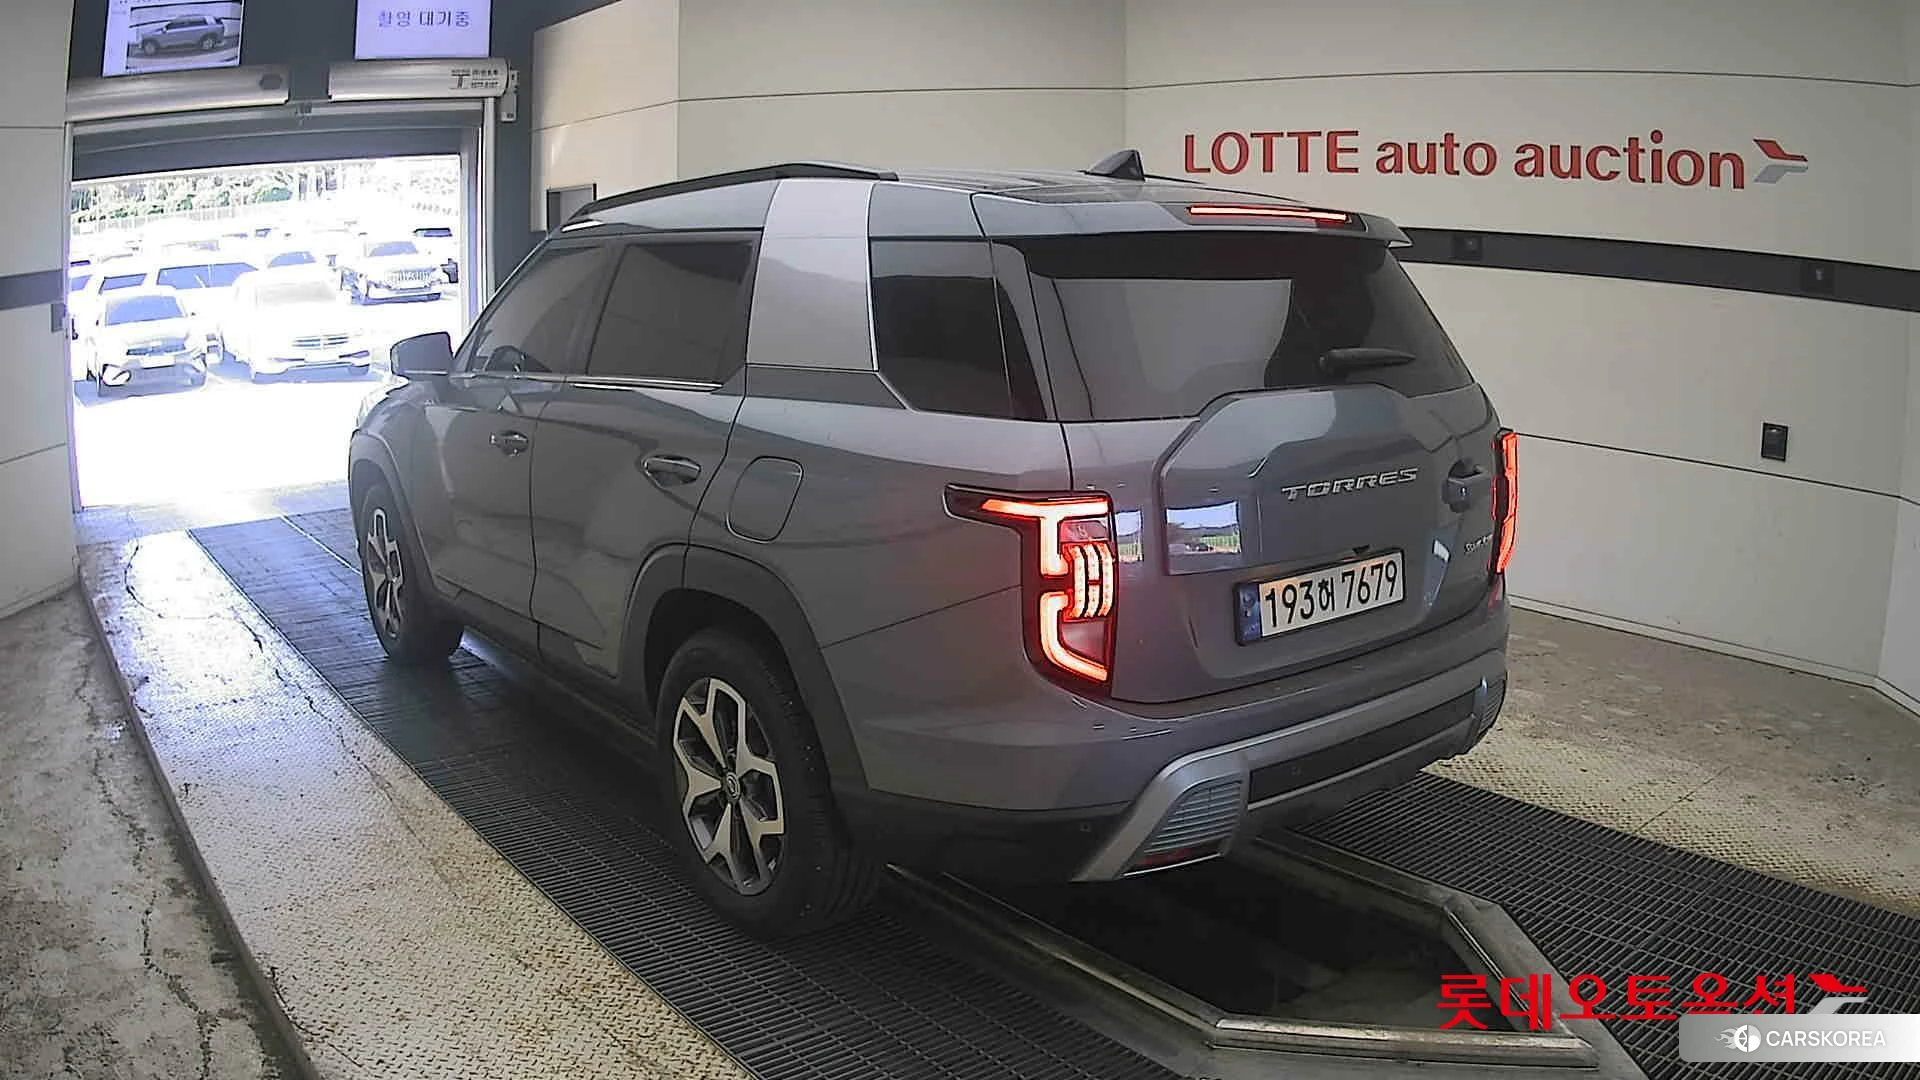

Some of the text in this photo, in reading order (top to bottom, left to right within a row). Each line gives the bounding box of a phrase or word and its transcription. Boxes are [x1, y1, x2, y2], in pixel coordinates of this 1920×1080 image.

[419, 9, 470, 28] 대기중
[1184, 129, 1746, 190] LOTTE auto auction
[1281, 467, 1419, 501] TORRES
[1264, 559, 1398, 628] 193허 7679
